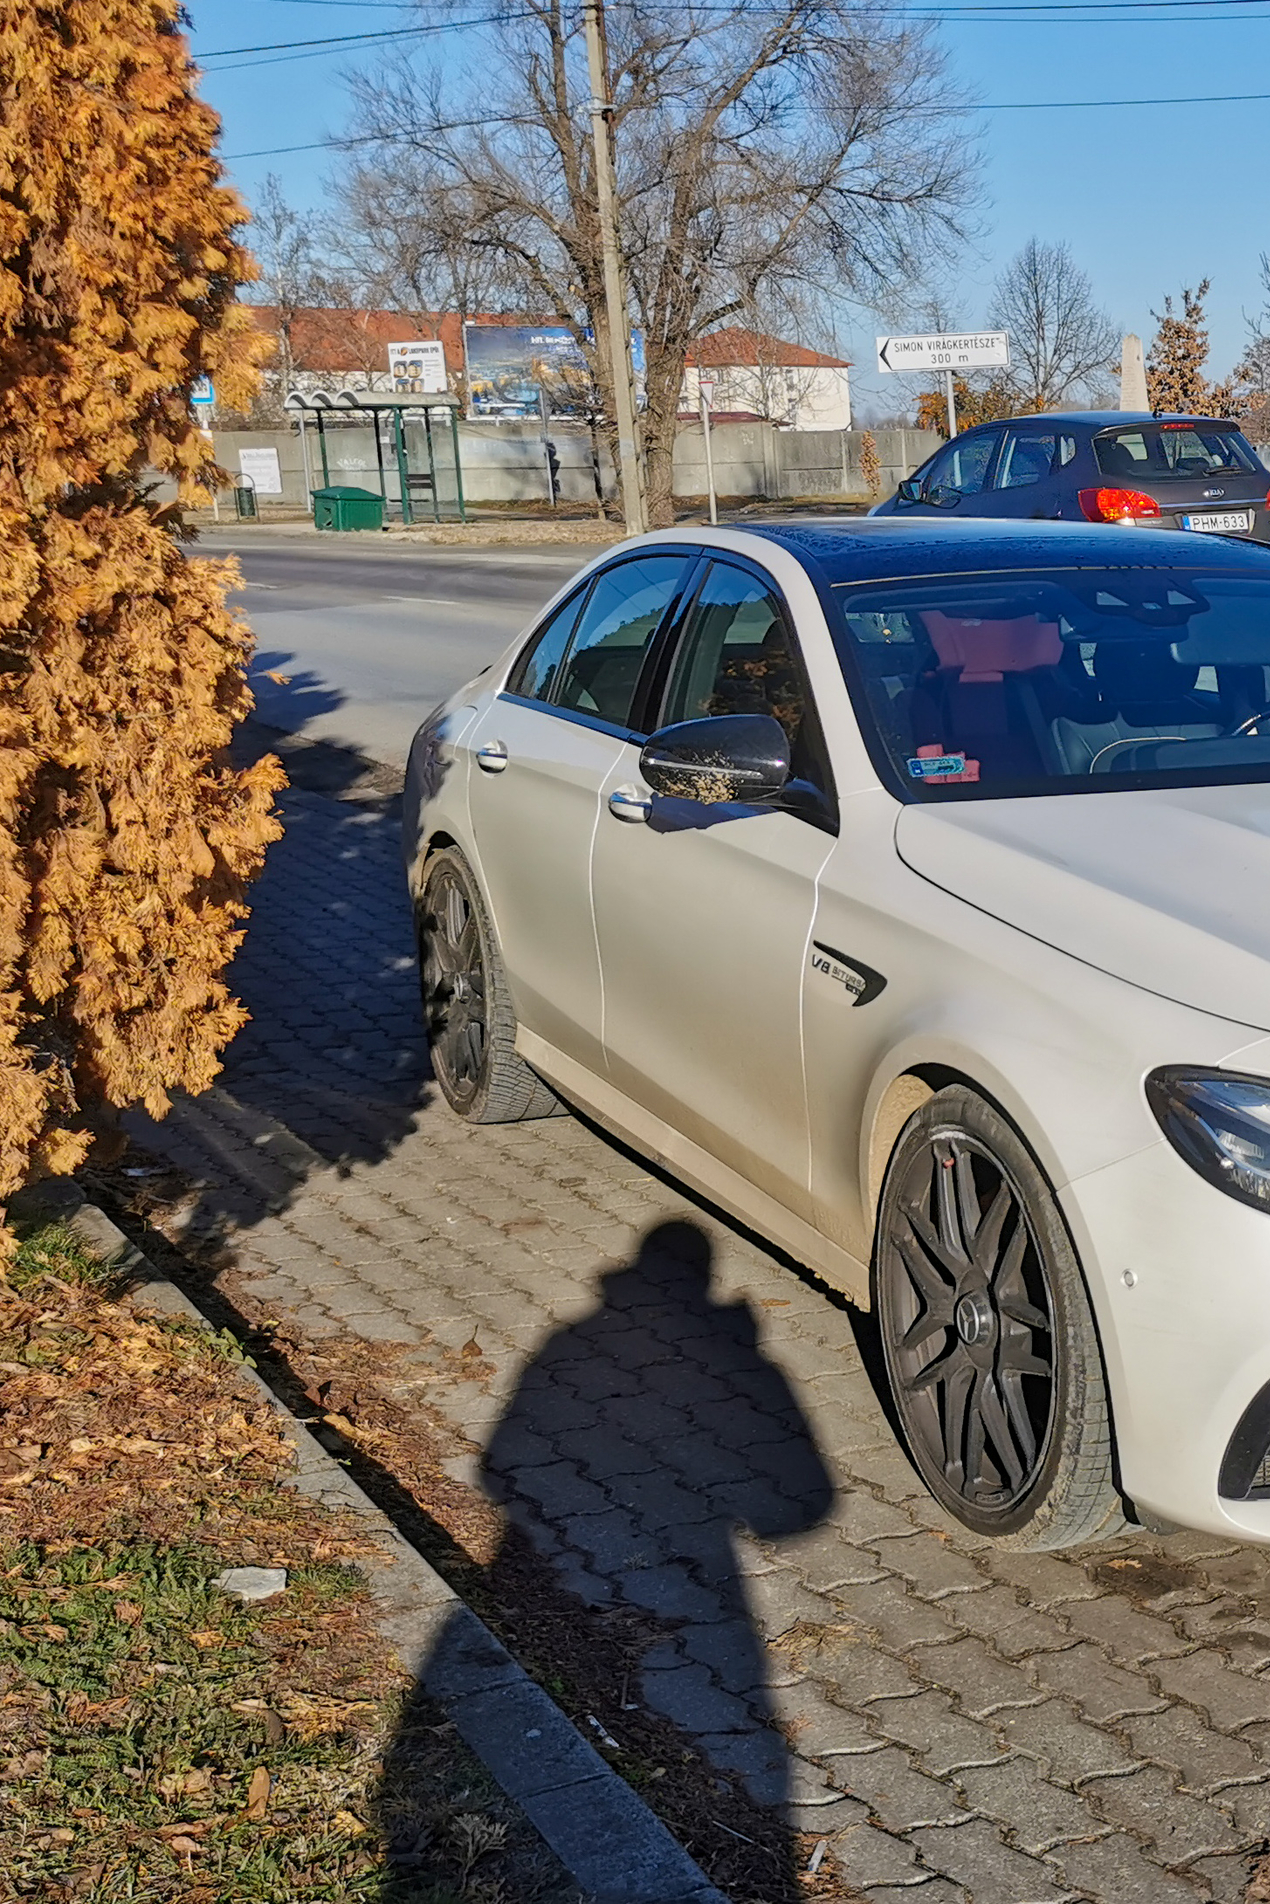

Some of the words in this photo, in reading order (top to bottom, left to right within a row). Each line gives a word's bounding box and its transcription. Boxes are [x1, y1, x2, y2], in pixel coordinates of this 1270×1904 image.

[894, 341, 924, 353] SIMON
[930, 353, 951, 364] 300
[958, 354, 969, 362] m
[1192, 515, 1245, 530] PHM-633
[811, 954, 831, 975] V8
